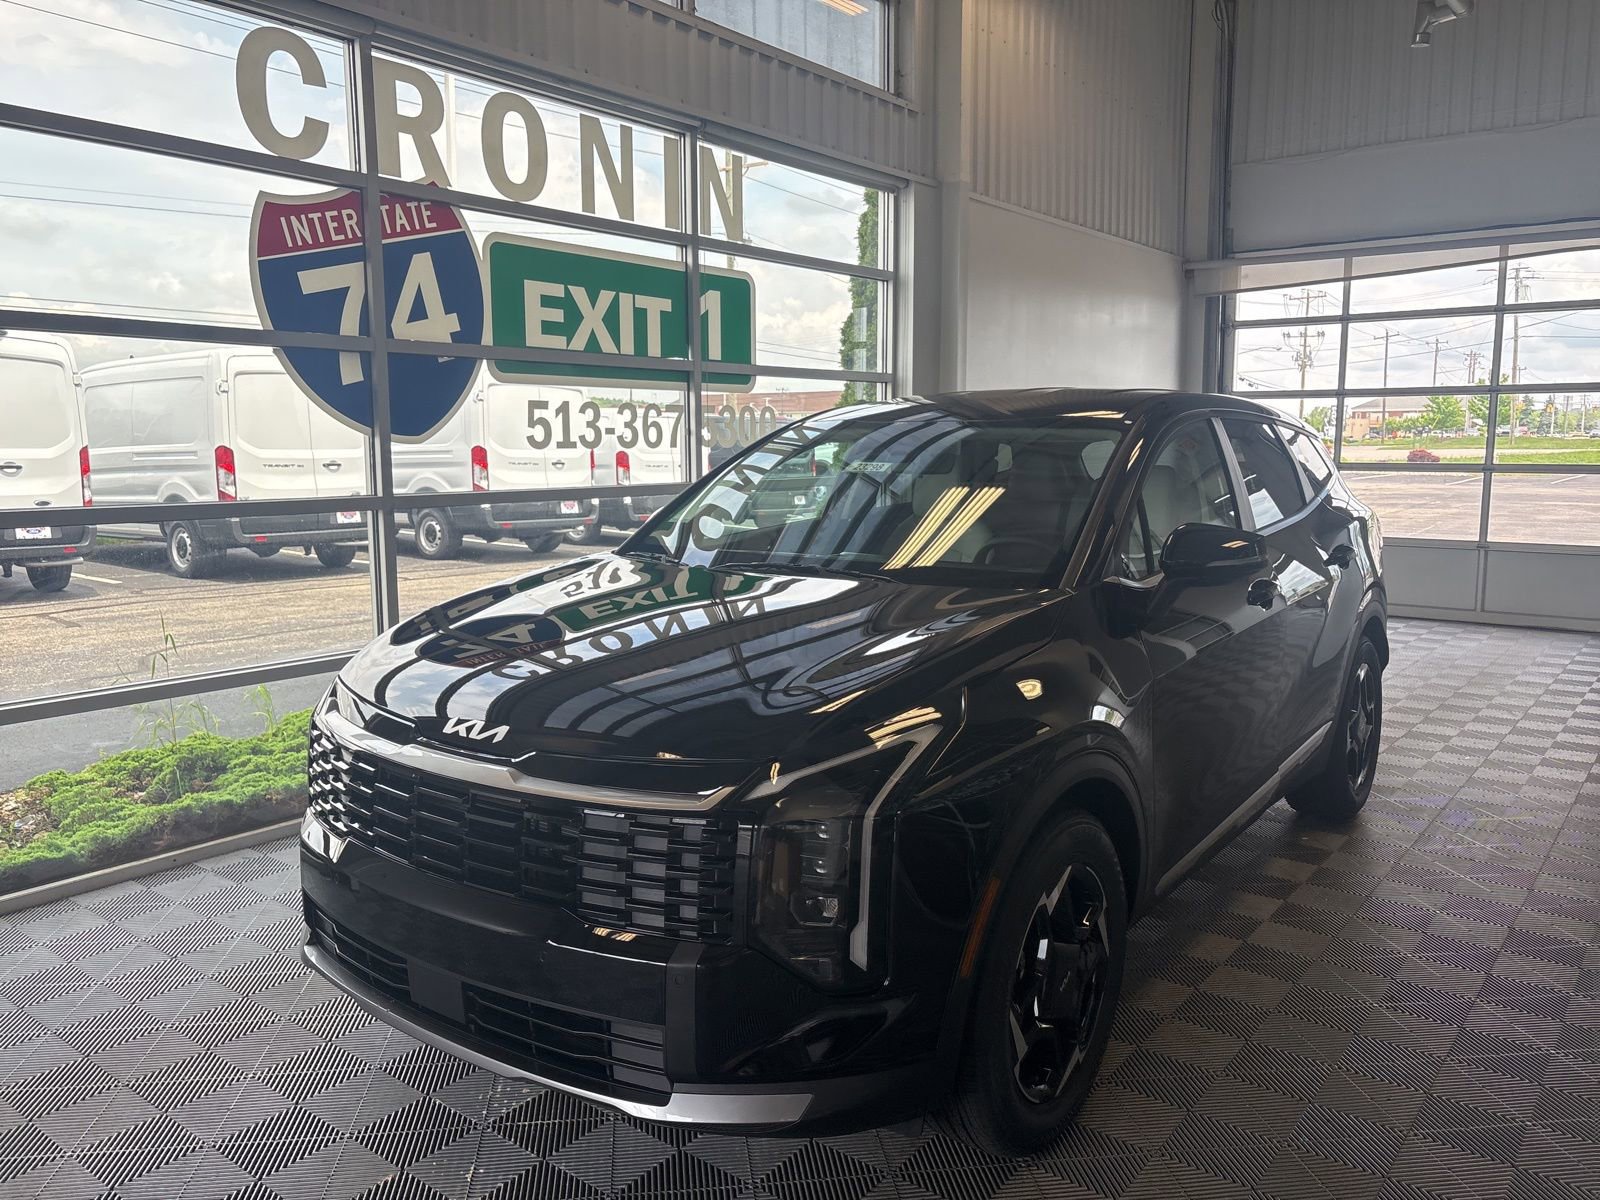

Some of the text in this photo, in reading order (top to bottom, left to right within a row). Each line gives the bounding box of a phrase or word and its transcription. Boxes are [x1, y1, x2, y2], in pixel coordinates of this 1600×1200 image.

[236, 26, 743, 240] CRONIN
[280, 201, 437, 248] INTERTATE
[297, 252, 461, 386] 74
[523, 279, 722, 361] EXIT 1
[526, 399, 777, 450] 513-3675300
[442, 716, 510, 743] KIA
